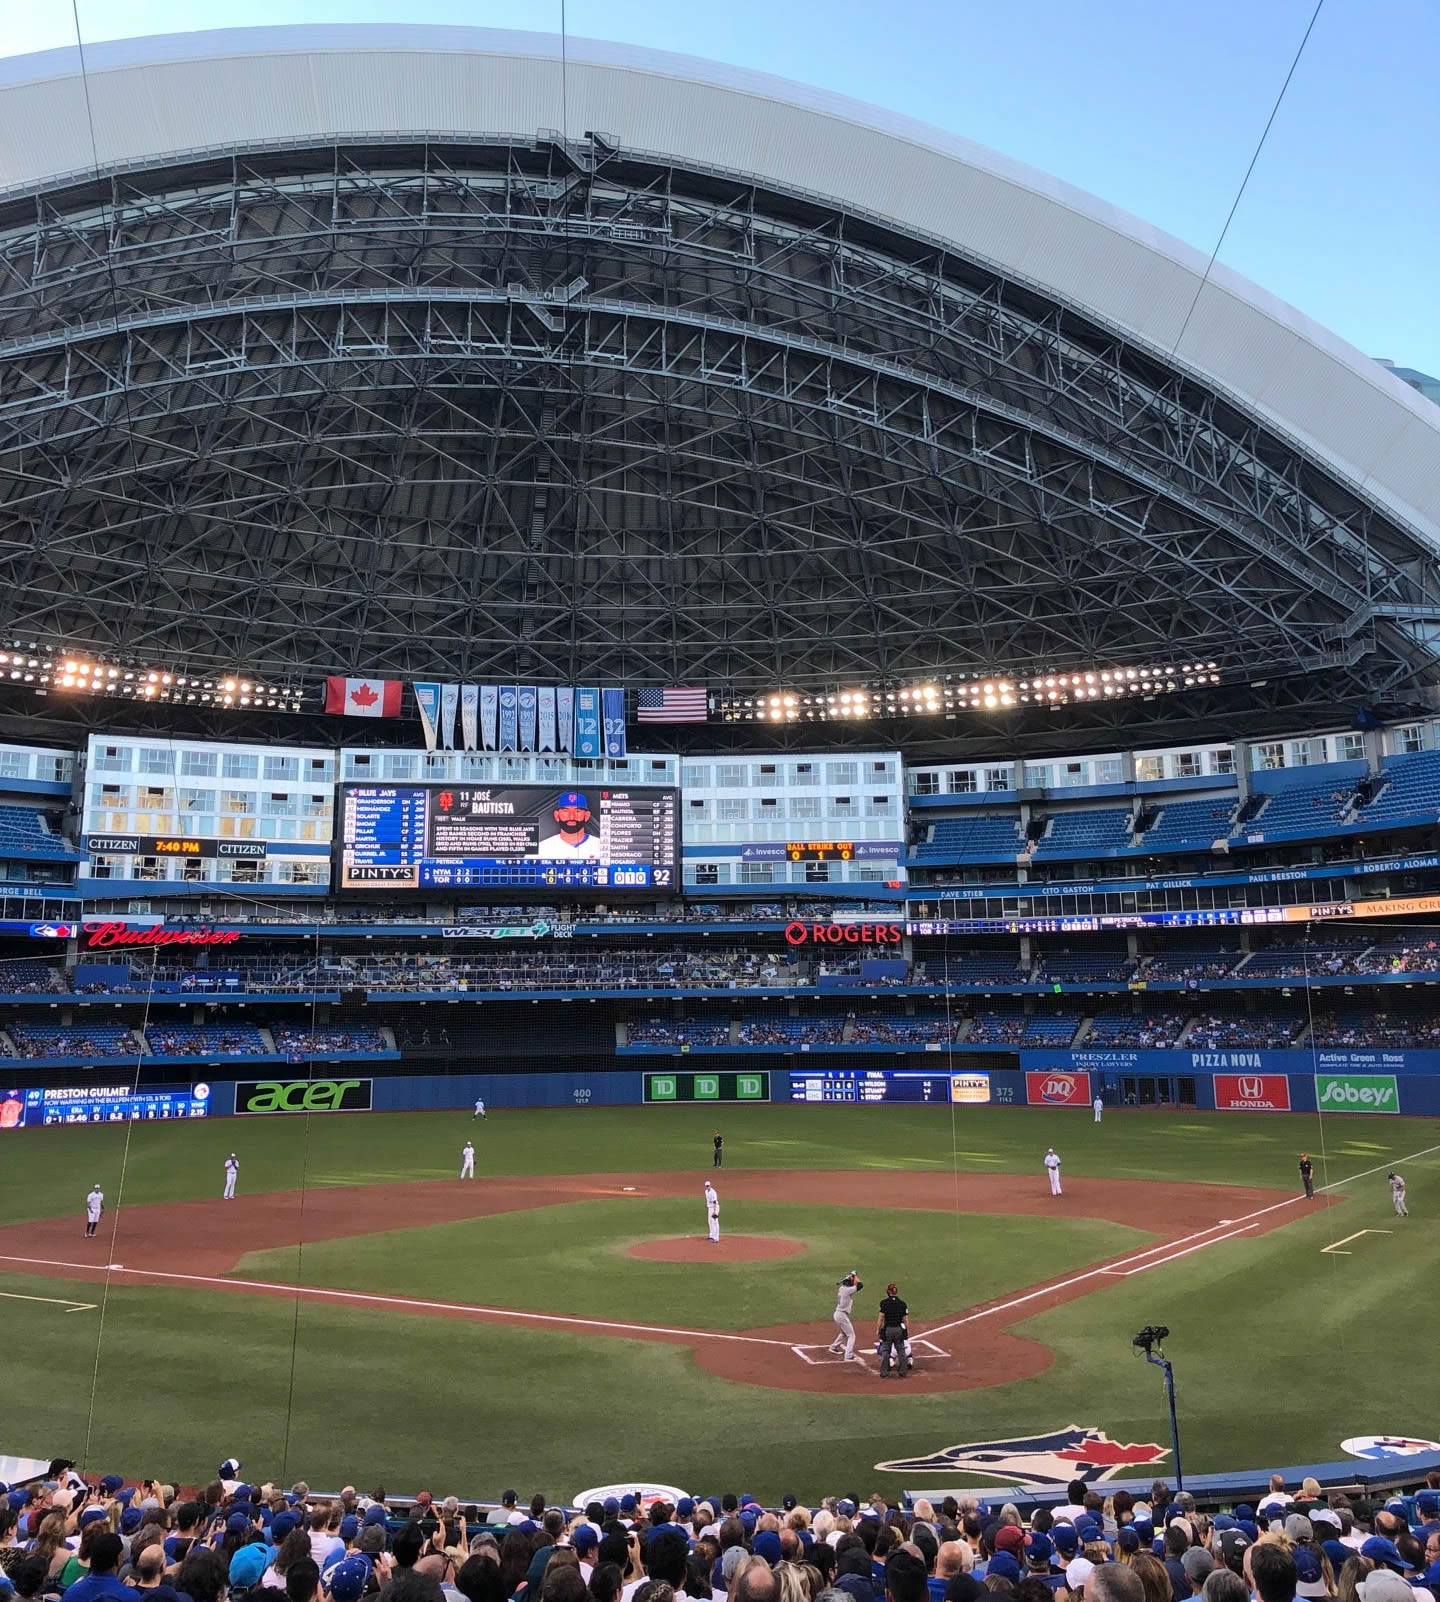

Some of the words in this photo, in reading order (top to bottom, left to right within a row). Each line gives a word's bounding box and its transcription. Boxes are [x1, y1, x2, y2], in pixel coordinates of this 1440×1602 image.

[502, 710, 514, 720] 1992
[520, 710, 533, 720] 1993
[540, 712, 554, 720] 2015
[559, 712, 572, 720] 2016
[578, 719, 596, 734] 12
[605, 719, 624, 734] 32
[460, 792, 469, 800] 11
[472, 790, 490, 800] JOSÉ
[472, 803, 514, 814] BAUTISTA
[89, 838, 137, 850] CITIZEN
[156, 841, 180, 852] 7:40
[182, 842, 199, 852] PM
[219, 844, 265, 854] CITIZEN
[792, 851, 800, 859] 0
[818, 851, 823, 859] 1
[842, 850, 850, 859] 0
[1364, 862, 1400, 872] ROBERTO
[1404, 858, 1438, 868] ALOMAR
[351, 868, 411, 878] PINTY'S
[616, 874, 622, 882] 0
[638, 874, 644, 882] 0
[654, 870, 670, 881] 92
[1249, 874, 1267, 882] PAUL
[1271, 872, 1306, 880] BEESTON
[1311, 906, 1353, 916] PINTY'S
[1366, 902, 1414, 913] MAKING
[83, 921, 240, 947] Budweiser
[443, 927, 528, 938] WESTJET
[813, 924, 901, 942] ROGERS
[1192, 1054, 1227, 1067] PIZZA
[1231, 1054, 1261, 1067] NOVA
[654, 1080, 674, 1094] TD
[696, 1080, 717, 1094] TD
[739, 1080, 759, 1093] TD
[996, 1088, 1013, 1096] 375
[1047, 1081, 1070, 1096] DQ
[45, 1088, 88, 1099] PRESTON
[90, 1087, 129, 1097] GUILMET
[247, 1082, 360, 1112] acer
[574, 1089, 591, 1098] 400
[1321, 1081, 1393, 1106] Sobeys
[1230, 1100, 1274, 1108] HONDA
[190, 1108, 204, 1116] 2.19
